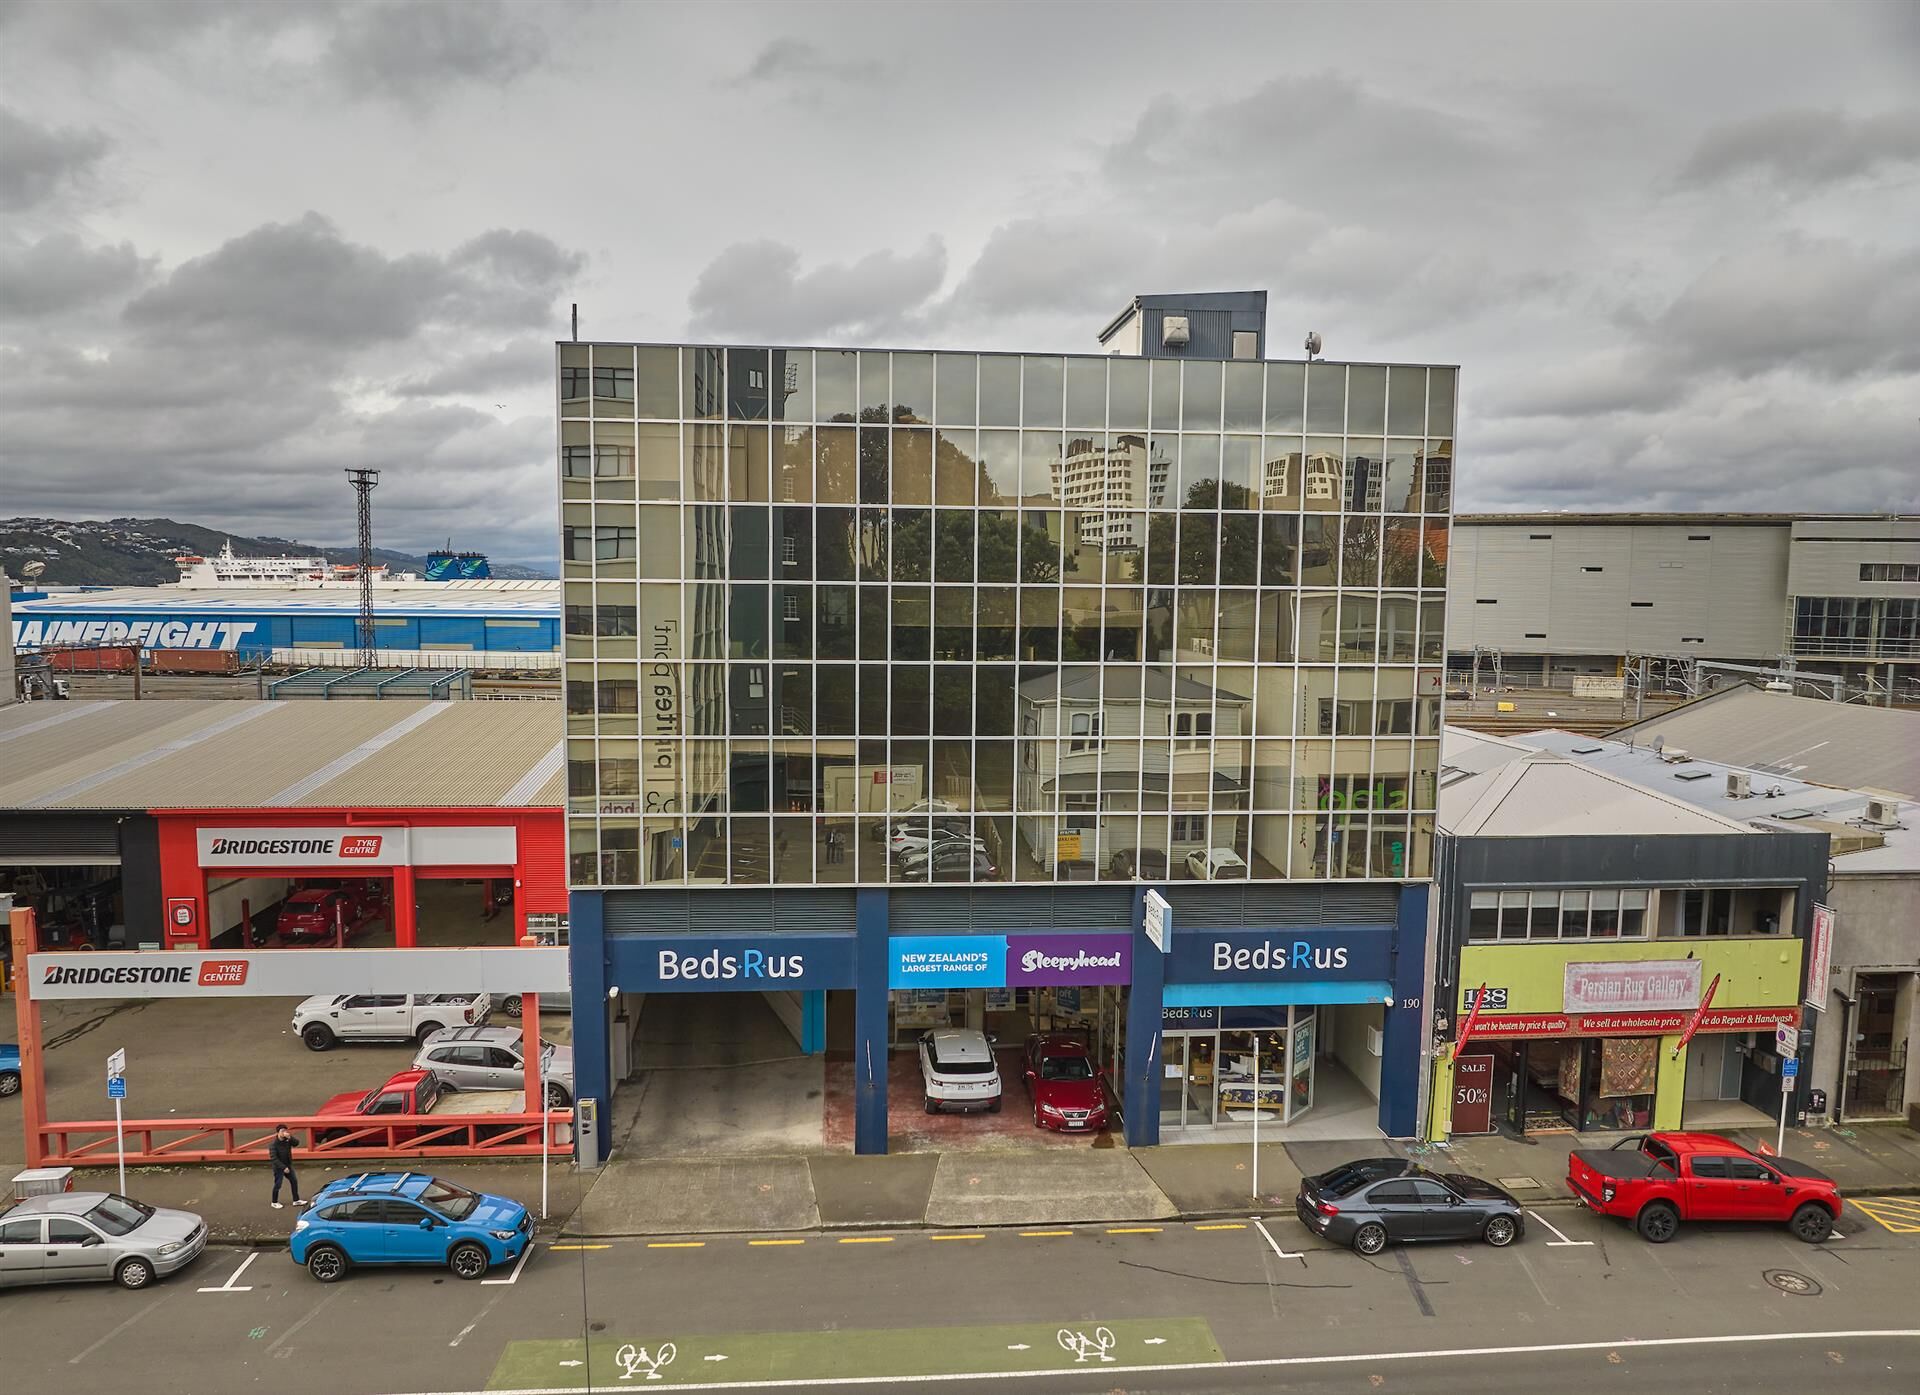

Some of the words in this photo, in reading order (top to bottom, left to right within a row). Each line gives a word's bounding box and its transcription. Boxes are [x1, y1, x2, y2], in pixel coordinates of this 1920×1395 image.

[13, 621, 257, 650] AINFREIGHT
[211, 839, 334, 854] BRIDGESTONE
[357, 839, 378, 847] TYRE
[343, 846, 376, 854] CENTRE
[902, 954, 927, 963] NEW
[929, 952, 988, 962] ZEALAND'S
[1021, 950, 1121, 973] Sleepyhead
[218, 965, 244, 973] TYRE
[902, 964, 941, 972] LARGEST
[942, 964, 973, 972] RANGE
[974, 963, 988, 971] OF
[43, 966, 192, 984] BRIDGESTONE
[203, 973, 242, 982] CENTRE
[1580, 977, 1621, 995] Persian
[1624, 976, 1645, 996] Rug
[1647, 975, 1687, 997] Gallery
[1402, 998, 1420, 1009] 190
[1474, 1021, 1490, 1031] won't
[1491, 1020, 1498, 1030] be
[1499, 1020, 1518, 1030] beaten
[1519, 1019, 1526, 1032] by
[1526, 1019, 1541, 1032] price
[1541, 1020, 1547, 1029] &
[1547, 1019, 1567, 1031] quality
[1583, 1019, 1596, 1028] We
[1597, 1018, 1610, 1027] sell
[1612, 1019, 1620, 1027] at
[1622, 1017, 1660, 1027] wholesale
[1661, 1017, 1681, 1029] price
[1711, 1015, 1720, 1024] do
[1722, 1015, 1746, 1026] Repair
[1747, 1014, 1753, 1024] &
[1755, 1013, 1793, 1024] Handwash
[1461, 1064, 1486, 1072] SALE
[1456, 1088, 1488, 1104] 50%
